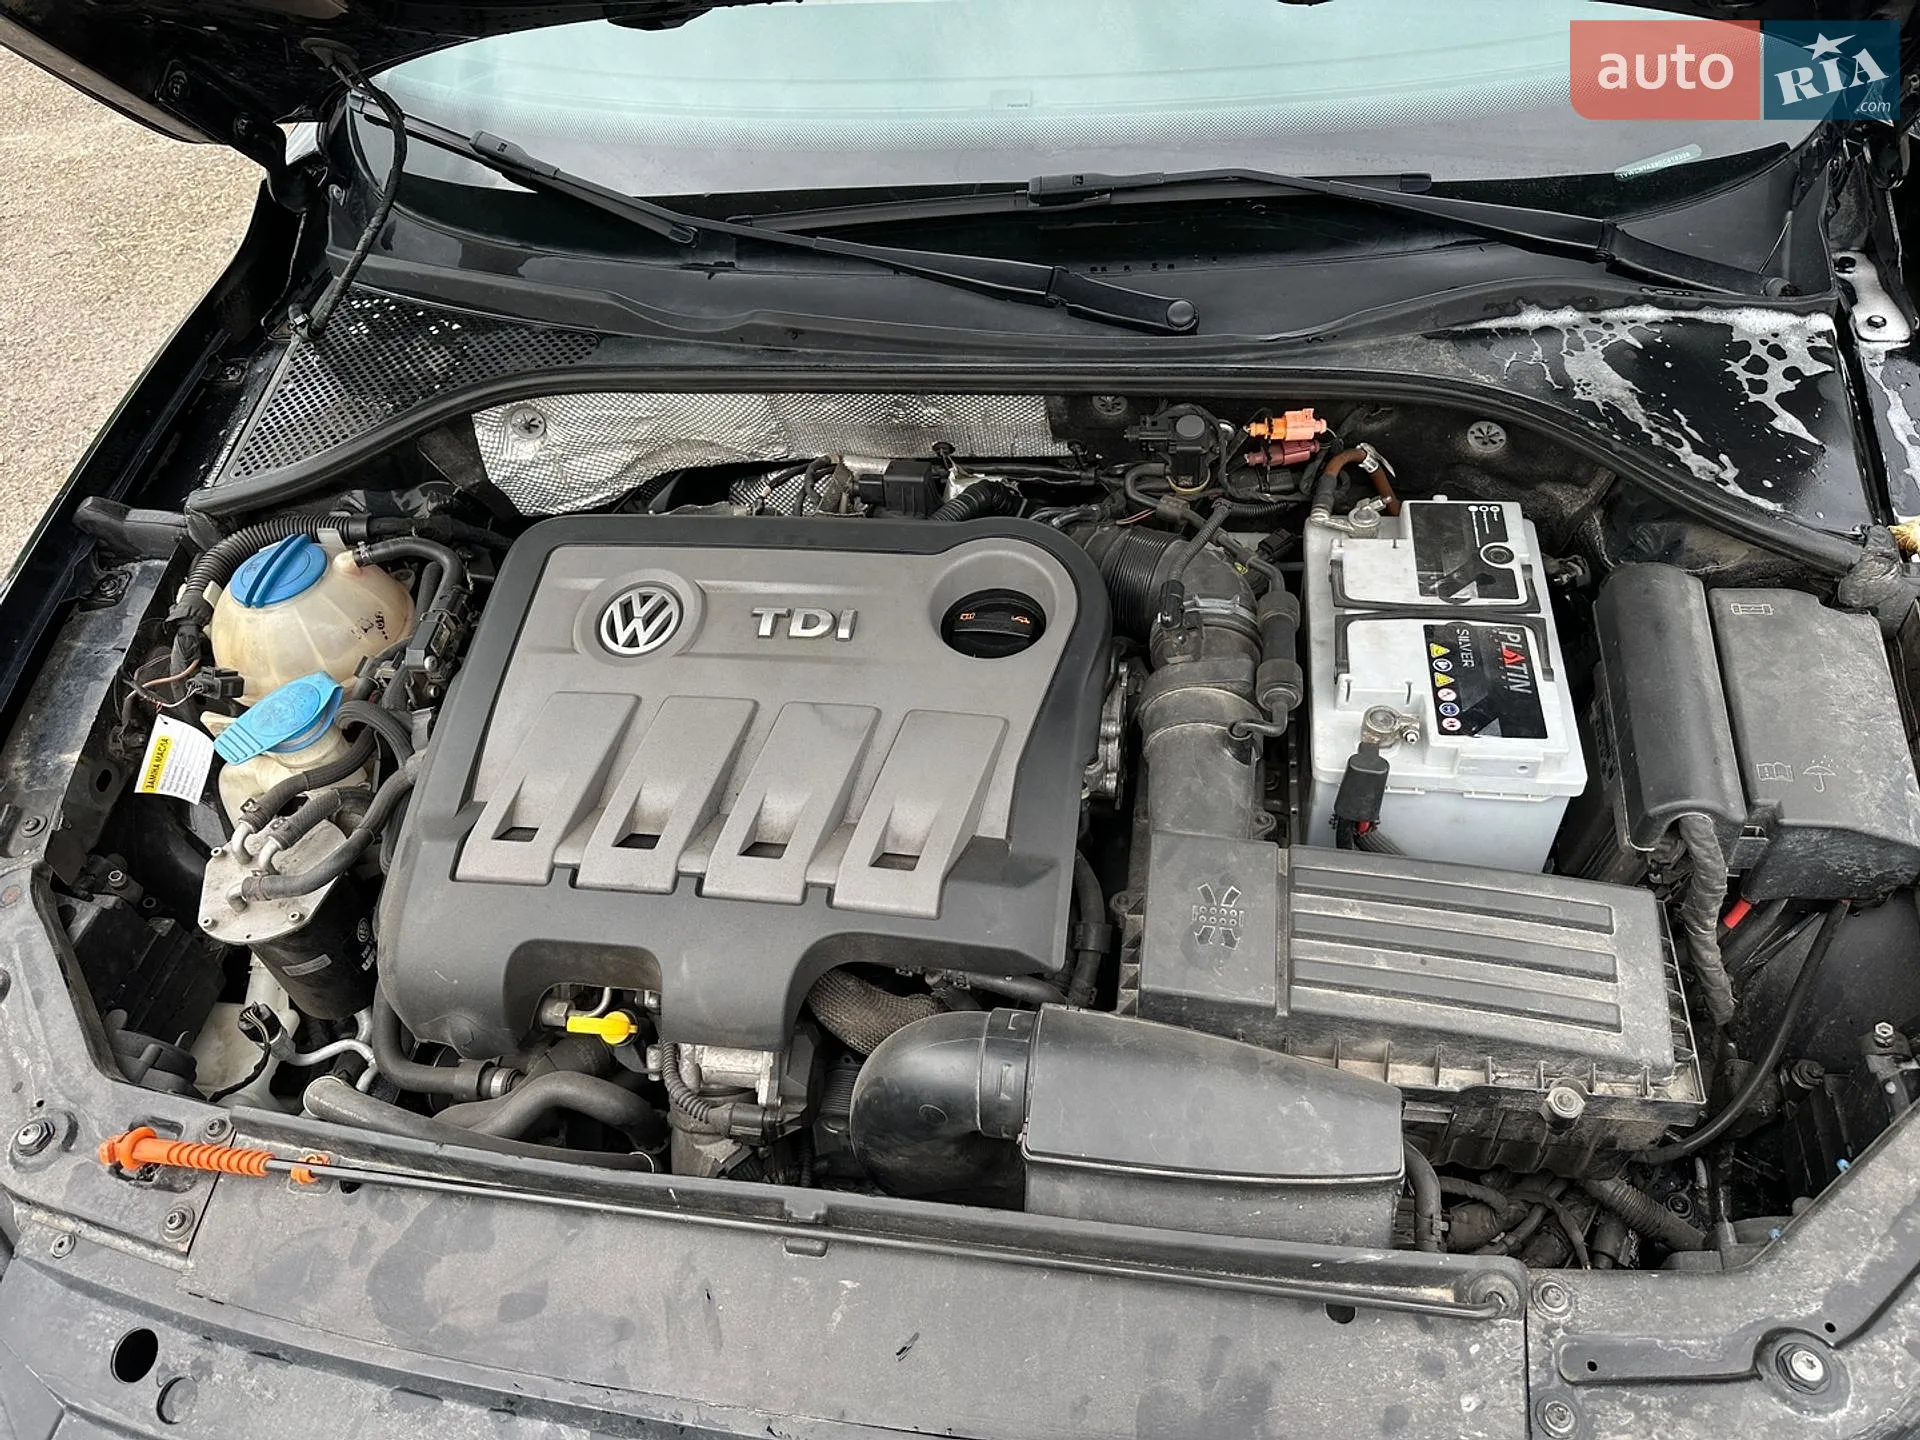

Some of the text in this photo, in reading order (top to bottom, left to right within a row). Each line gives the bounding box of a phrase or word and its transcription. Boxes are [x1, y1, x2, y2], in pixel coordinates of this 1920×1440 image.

[751, 607, 859, 642] TDI
[1457, 630, 1475, 668] SILVER
[1499, 631, 1532, 694] PLATIN
